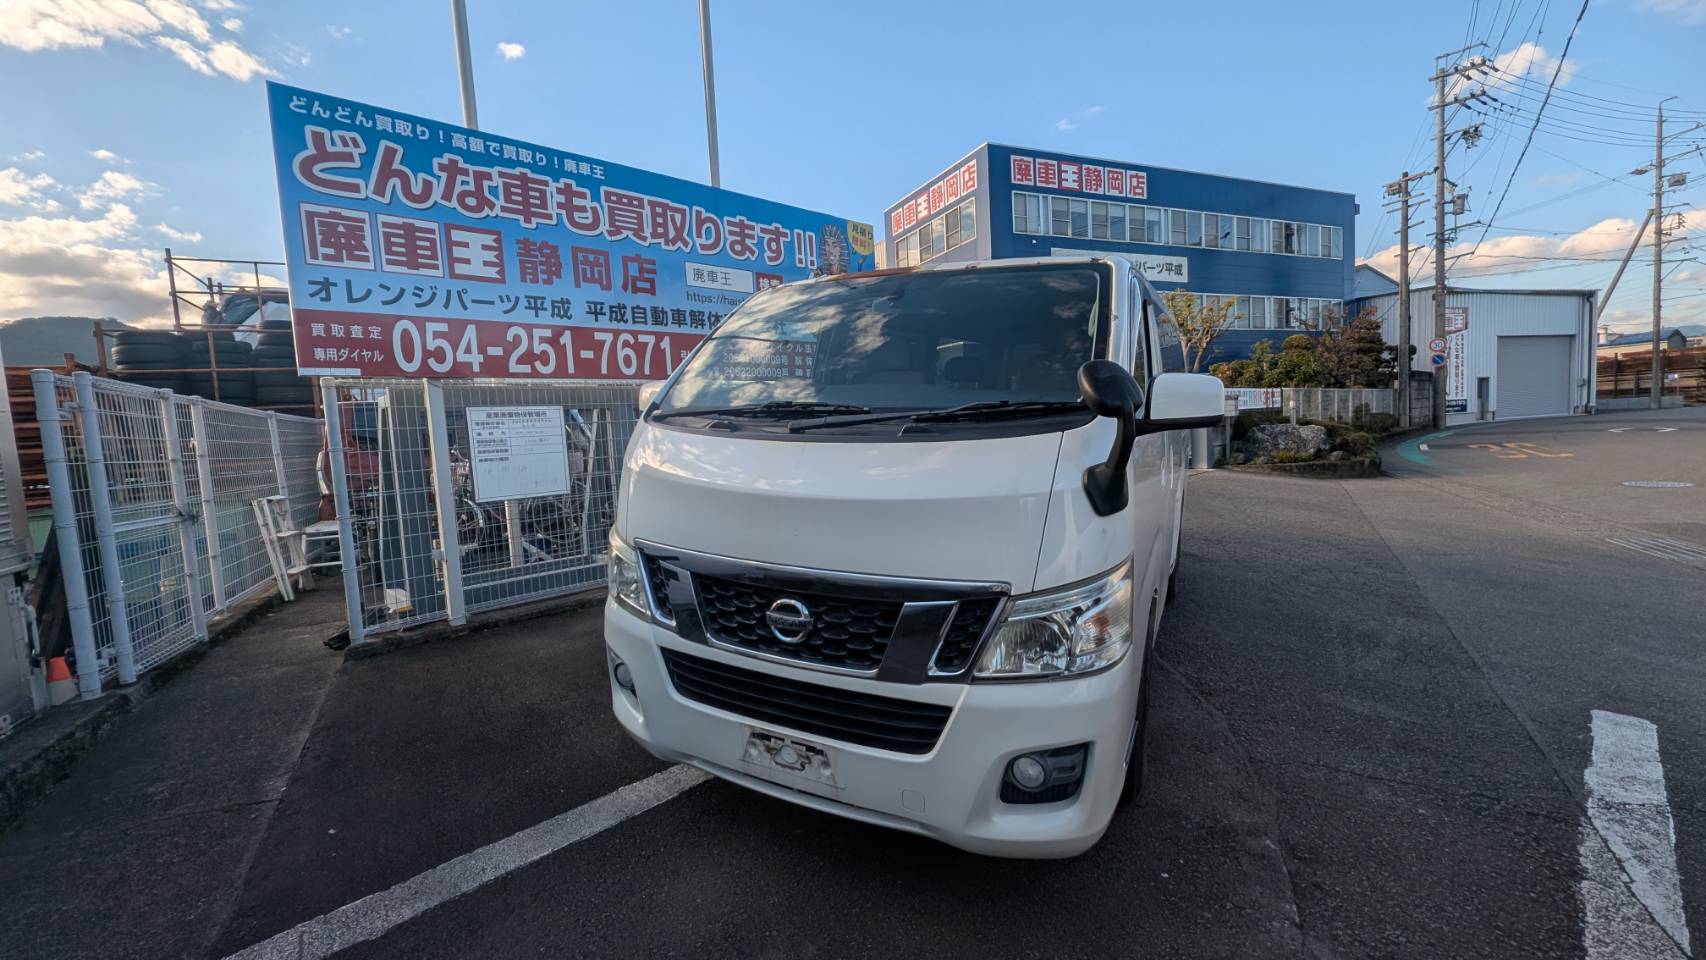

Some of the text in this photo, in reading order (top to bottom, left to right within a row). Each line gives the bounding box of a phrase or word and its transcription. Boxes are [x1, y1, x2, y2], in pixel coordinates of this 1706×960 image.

[1011, 156, 1147, 198] 廃車王静岡店
[693, 268, 733, 287] 廃車王
[1134, 262, 1184, 276] パーツ平成
[307, 277, 730, 330] オレンジパーツ平成 平成自動車解体
[311, 323, 383, 339] 買取査定
[313, 347, 384, 363] 専用ダイヤル
[392, 319, 673, 376] 054-251-7671
